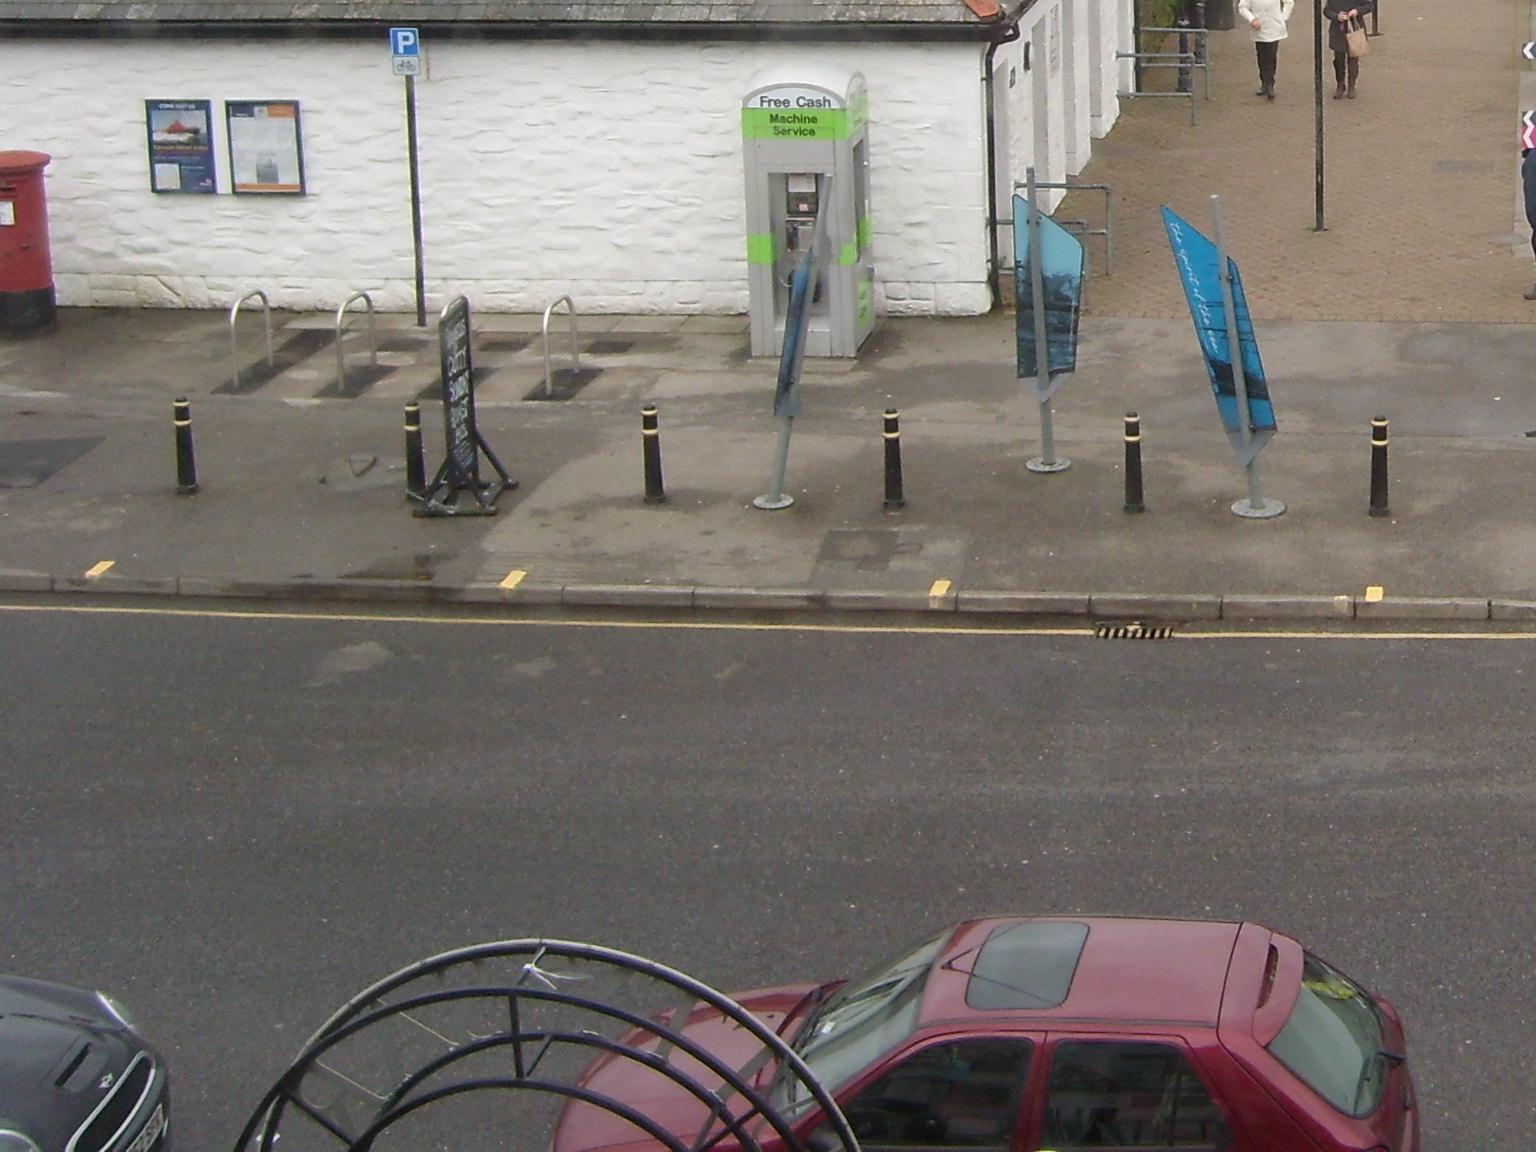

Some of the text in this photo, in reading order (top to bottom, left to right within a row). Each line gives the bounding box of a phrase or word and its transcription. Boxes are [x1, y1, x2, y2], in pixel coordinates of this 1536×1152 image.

[398, 31, 415, 54] P
[760, 96, 831, 108] Free Cash
[769, 113, 817, 124] Machine
[773, 125, 816, 137] Service
